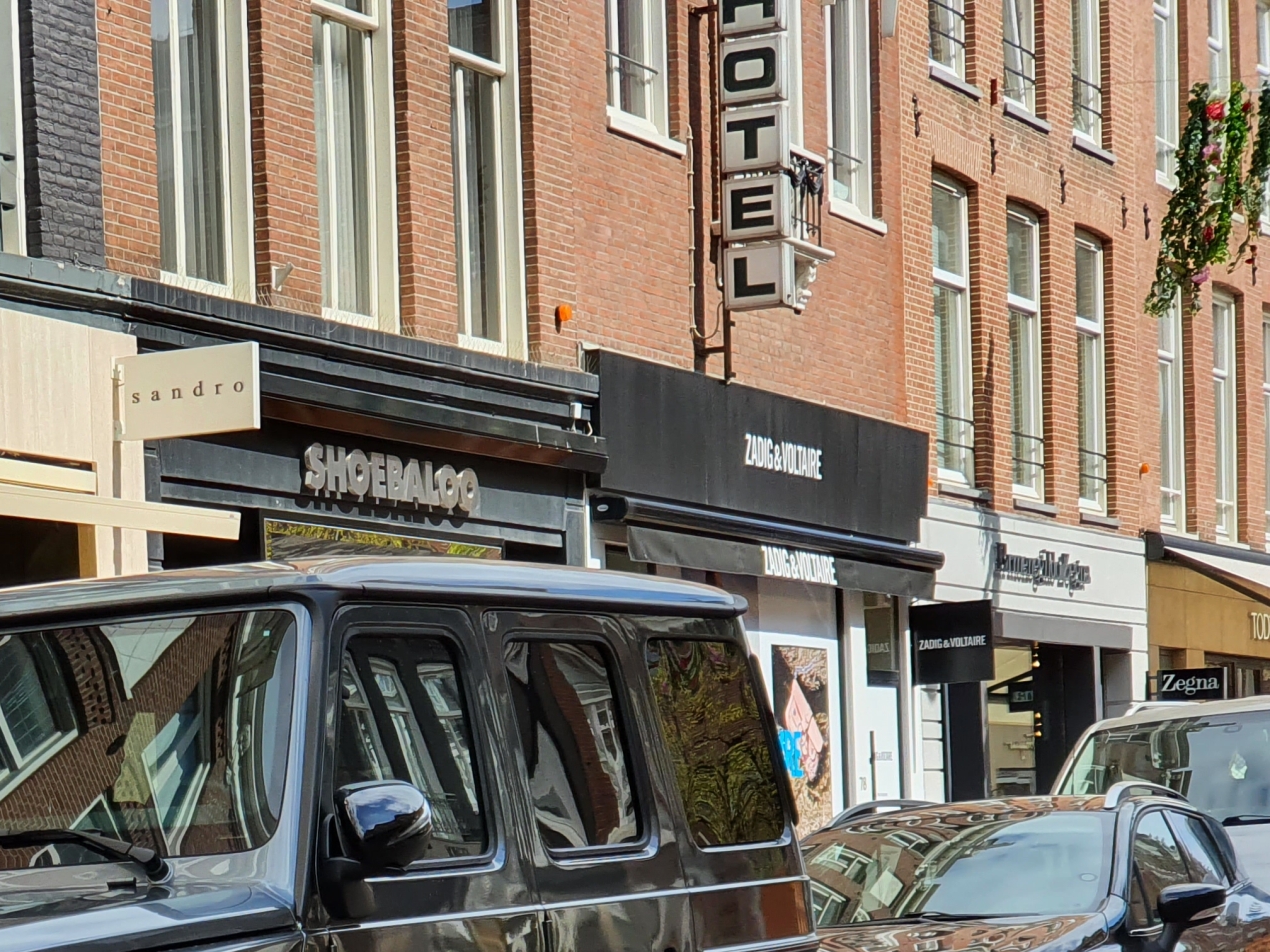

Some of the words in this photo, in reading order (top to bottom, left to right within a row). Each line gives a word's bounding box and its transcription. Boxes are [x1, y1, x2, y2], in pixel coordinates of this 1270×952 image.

[132, 380, 244, 404] sandro
[305, 442, 479, 513] SHOEBALOO
[1161, 674, 1220, 695] Zegna
